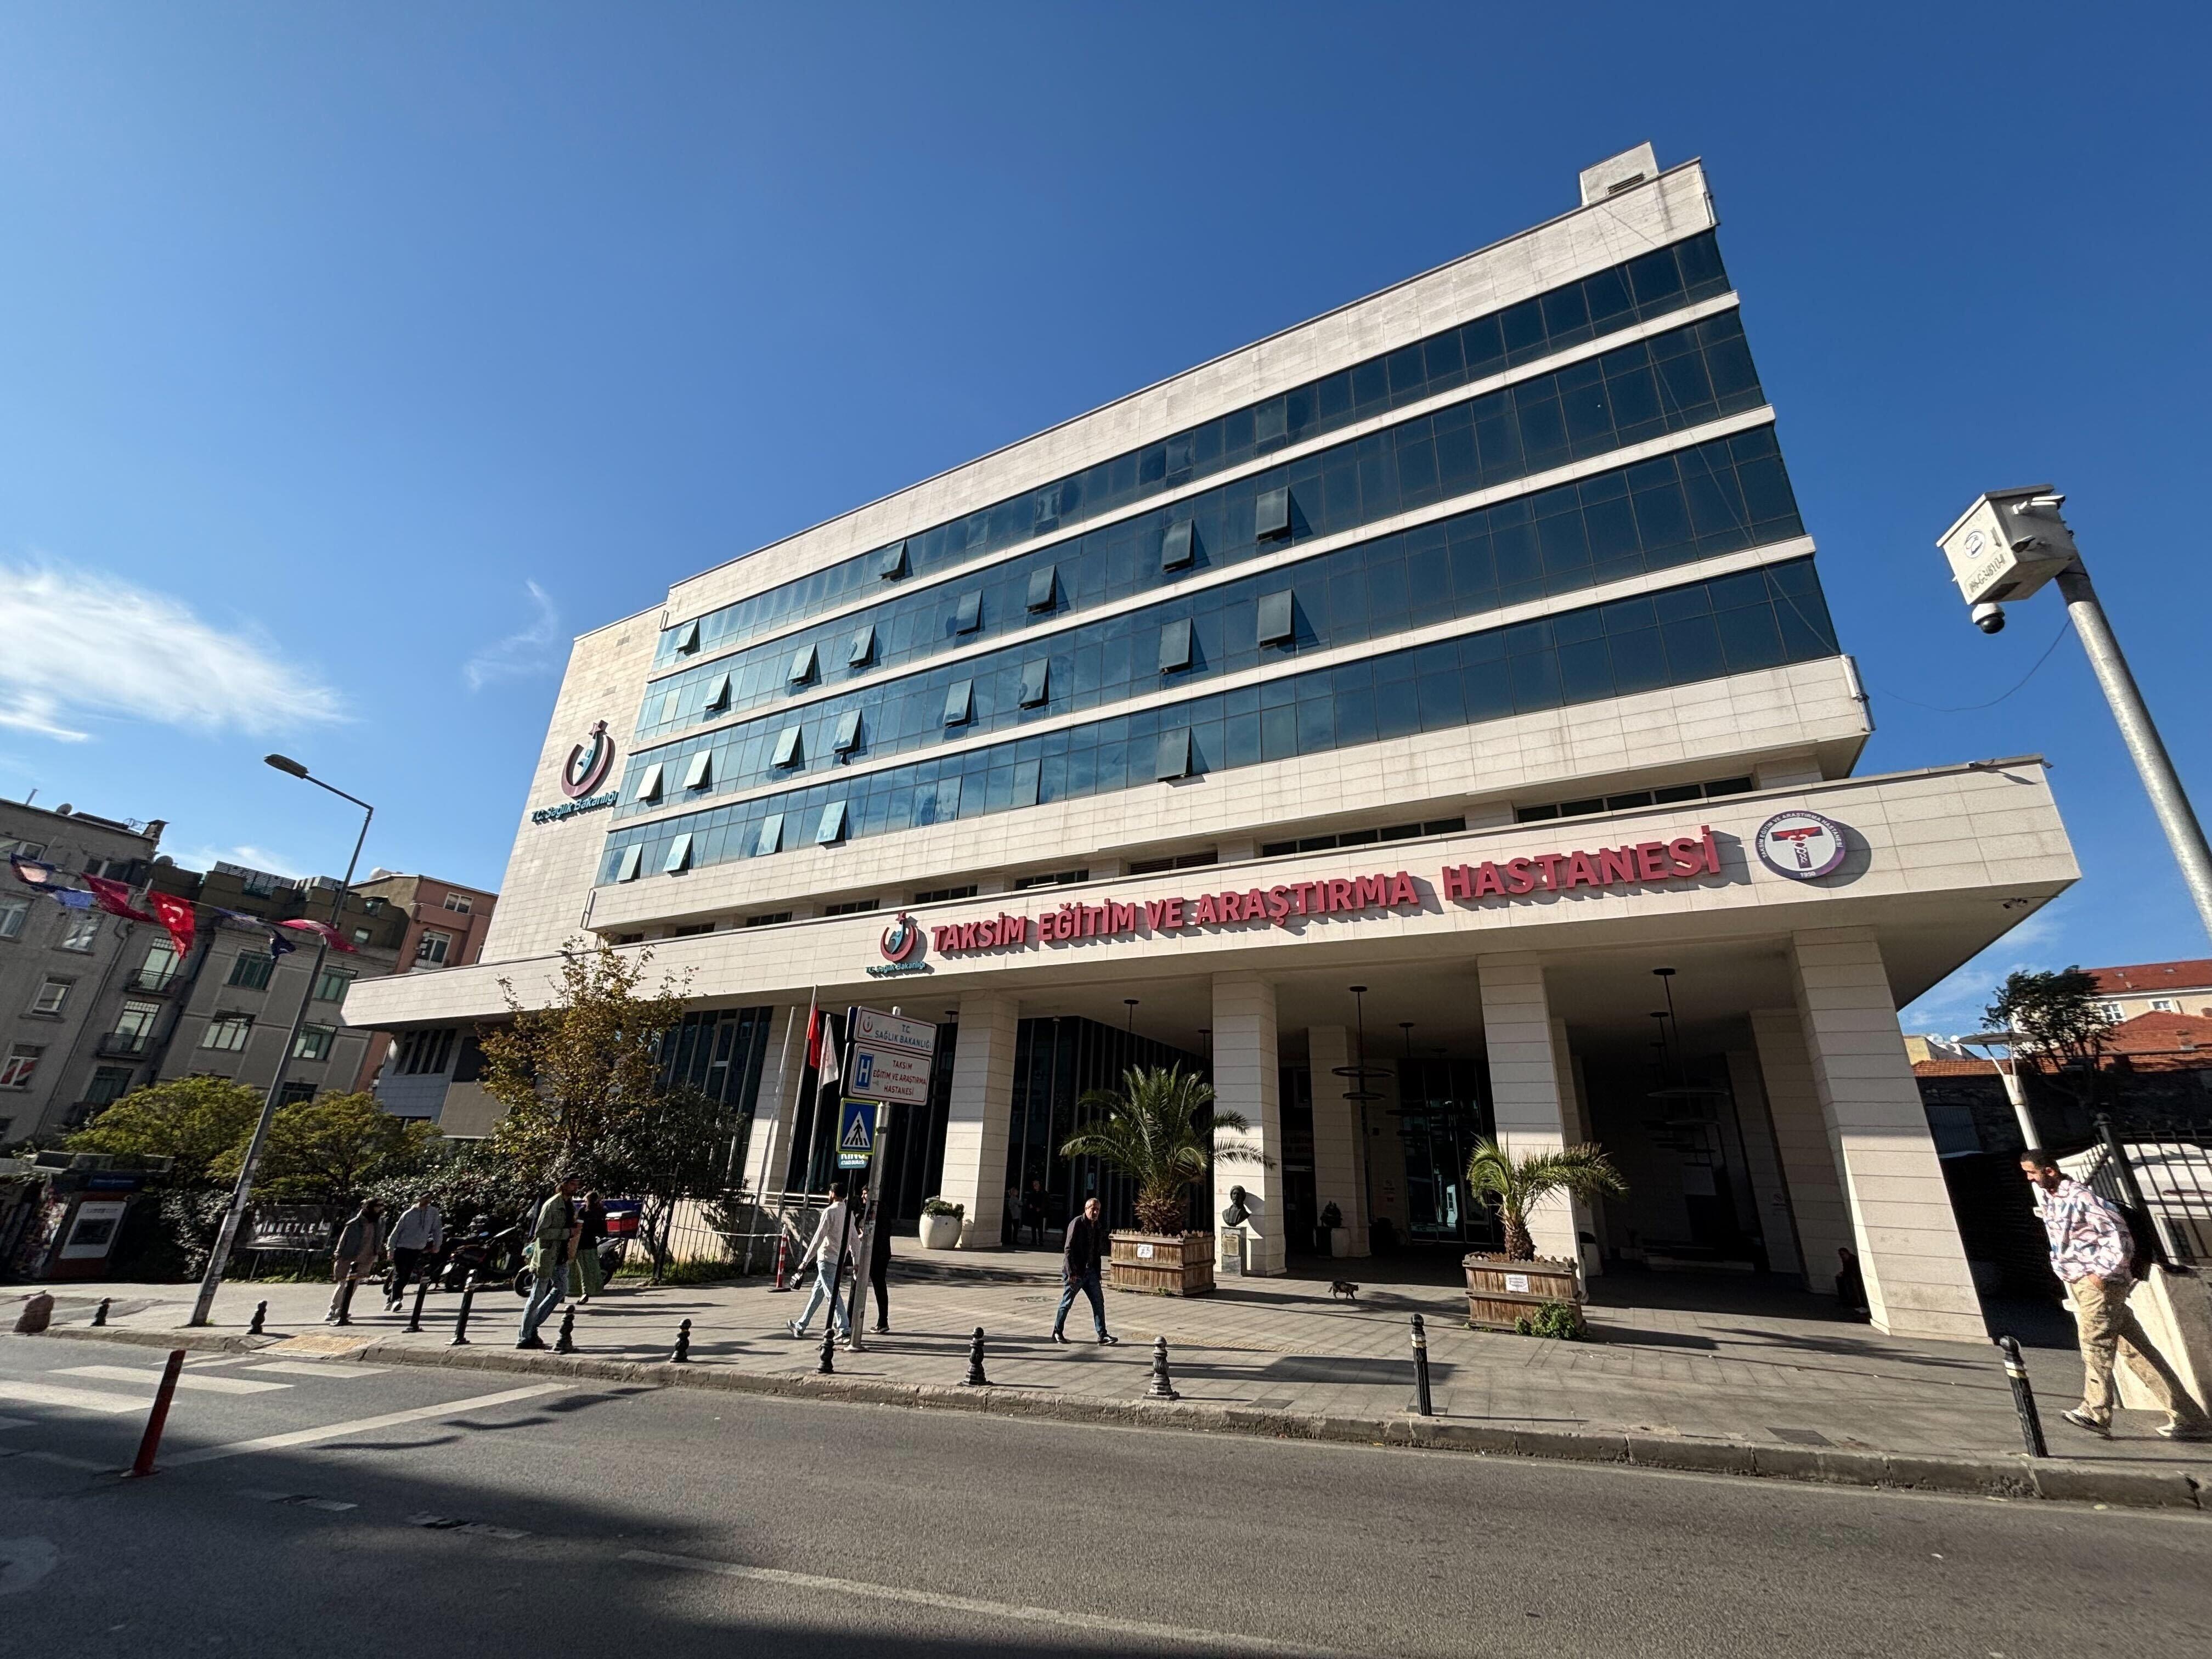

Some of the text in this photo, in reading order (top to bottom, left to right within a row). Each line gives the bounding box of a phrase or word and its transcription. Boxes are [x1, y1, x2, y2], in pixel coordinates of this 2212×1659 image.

[531, 790, 619, 822] T.C. Sağlık Bakanlığı
[1782, 812, 1821, 822] ARAŞTIRMA
[1759, 821, 1773, 838] EĞİTİM
[1821, 820, 1843, 848] HASTANESİ
[1758, 839, 1768, 859] TAKSİM
[931, 825, 1720, 952] TAKSİM EĞİTİM VE ARAŞTIRMA HASTANESİ
[895, 961, 926, 970] Bakanlığı
[874, 1030, 932, 1049] SAĞLIK BAKANLIĞI
[873, 1069, 891, 1080] EĞİTİM
[899, 1074, 927, 1085] ARAŞTIRMA
[884, 1085, 914, 1096] HASTANESİ
